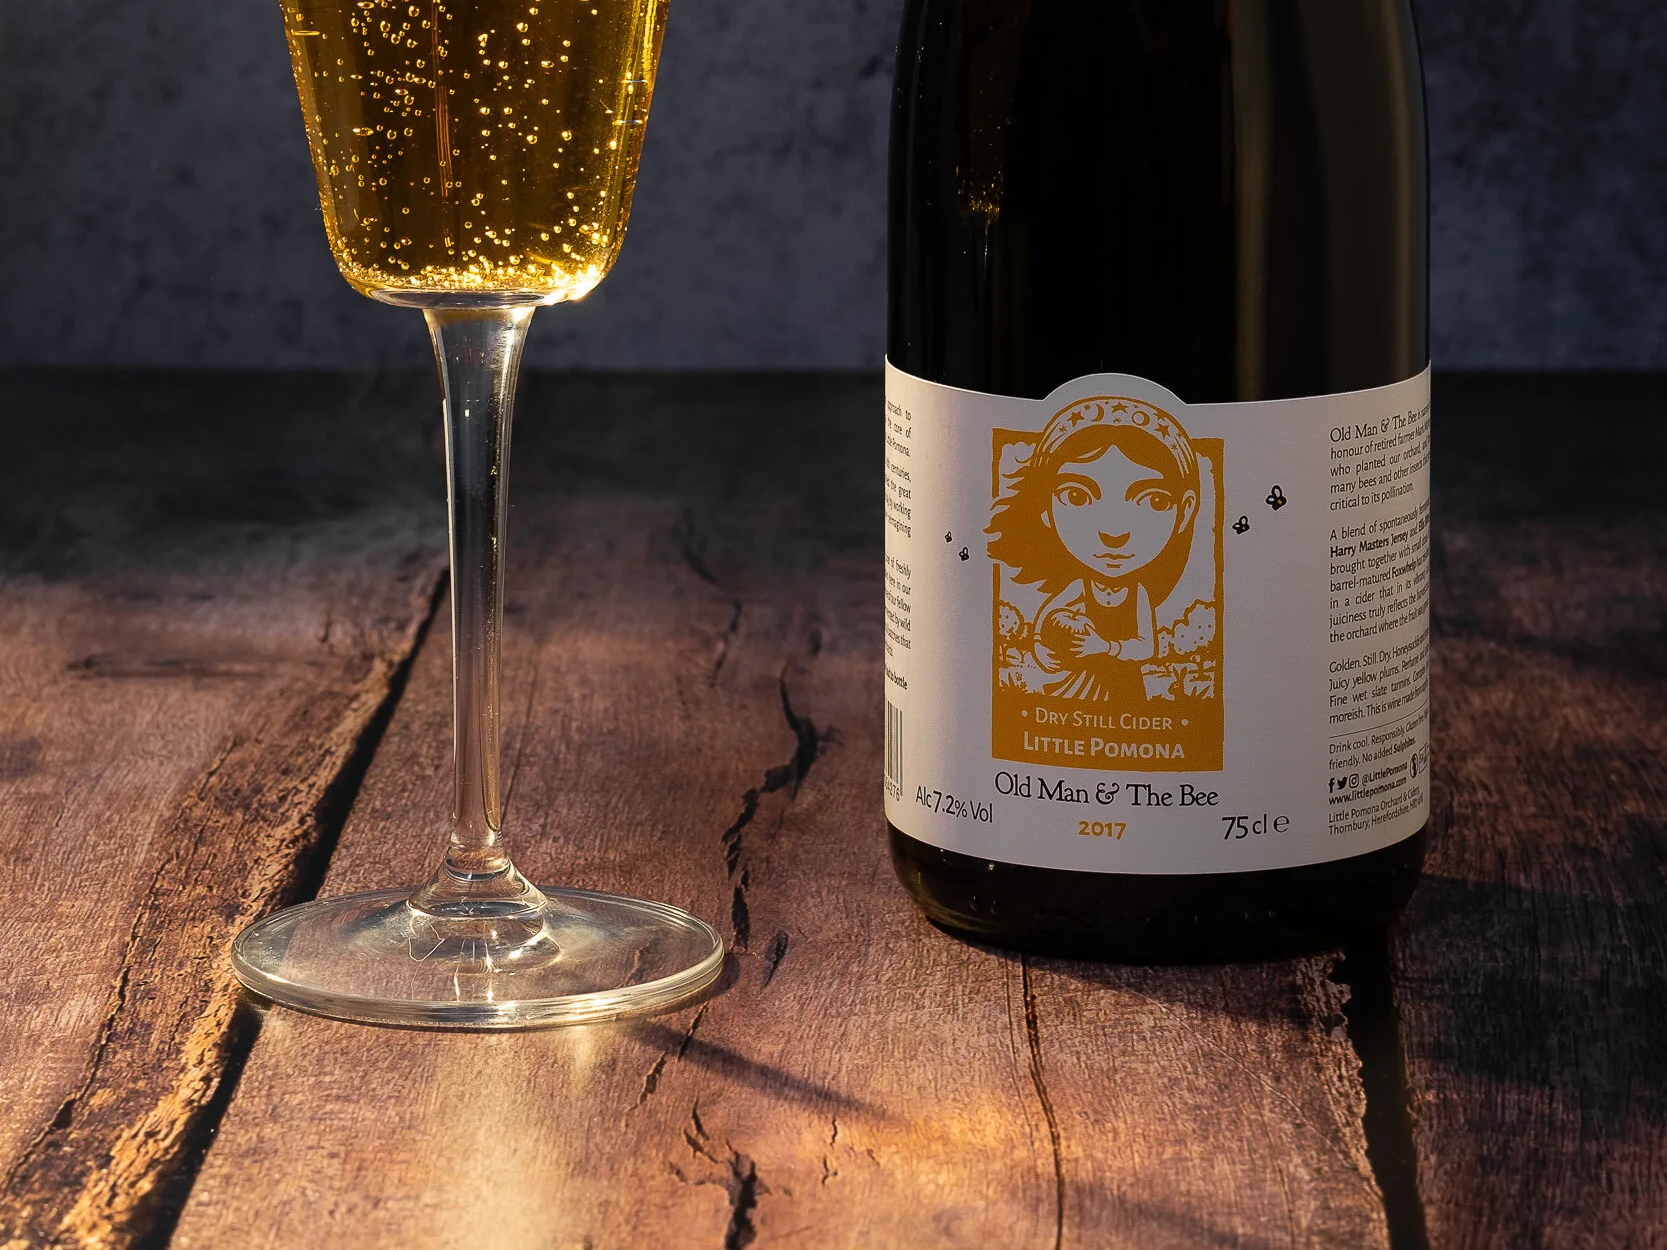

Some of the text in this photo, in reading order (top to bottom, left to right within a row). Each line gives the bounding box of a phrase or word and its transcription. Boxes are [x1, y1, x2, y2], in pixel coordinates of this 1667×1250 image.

[905, 427, 911, 439] of
[1330, 426, 1351, 442] Old
[1355, 423, 1378, 439] Man
[1381, 418, 1390, 433] &
[1392, 415, 1406, 430] The
[1408, 410, 1418, 425] Bee
[1330, 446, 1364, 459] honour
[1364, 440, 1373, 453] of
[1374, 434, 1396, 452] retired
[1397, 429, 1415, 446] farmer
[1330, 463, 1351, 476] who
[1356, 454, 1385, 475] planted
[1389, 453, 1401, 465] our
[1330, 479, 1356, 494] many
[1359, 477, 1377, 489] bees
[1378, 470, 1392, 484] and
[1394, 465, 1409, 481] other
[898, 487, 911, 499] great
[1330, 495, 1360, 511] critical
[1361, 495, 1370, 506] to
[1371, 490, 1380, 503] its
[1330, 529, 1337, 541] A
[1341, 523, 1366, 540] blend
[1368, 520, 1377, 534] of
[1380, 507, 1418, 532] spontaneously
[1330, 545, 1356, 558] Harry
[1359, 537, 1389, 553] Masters
[1391, 531, 1409, 546] Jersey
[1410, 526, 1418, 538] and
[896, 559, 911, 580] freshly
[1330, 558, 1365, 575] brought
[1368, 551, 1397, 569] together
[1399, 544, 1411, 559] with
[1330, 568, 1391, 592] barrel-matured
[1392, 559, 1416, 579] Foxwhelp
[902, 584, 911, 595] our
[1330, 597, 1339, 609] in
[1344, 597, 1350, 607] a
[1355, 591, 1375, 605] cider
[1379, 585, 1393, 599] that
[1397, 582, 1402, 594] in
[897, 595, 911, 613] fellow
[1329, 611, 1367, 629] juiciness
[1369, 603, 1386, 619] truly
[1387, 597, 1408, 614] reflects
[900, 619, 911, 632] wild
[1330, 631, 1345, 643] the
[1346, 622, 1378, 640] orchard
[1378, 619, 1398, 633] where
[1399, 614, 1408, 626] the
[901, 635, 911, 649] that
[1329, 658, 1361, 673] Golden.
[1363, 652, 1378, 667] Still.
[1380, 650, 1392, 664] Dry.
[1329, 678, 1350, 692] Juicy
[1352, 672, 1377, 689] yellow
[1329, 695, 1348, 707] Fine
[1352, 690, 1367, 703] wet
[1372, 684, 1388, 698] slate
[1329, 707, 1365, 724] moreish.
[1366, 702, 1380, 717] This
[1381, 700, 1387, 712] is
[1387, 697, 1401, 711] wine
[1402, 688, 1415, 704] made
[1329, 740, 1352, 755] Drink
[1353, 736, 1369, 750] cool.
[1329, 753, 1361, 770] friendly.
[1362, 753, 1373, 764] No
[1374, 745, 1393, 761] added
[1362, 762, 1408, 786] @LittlePomona
[995, 771, 1219, 807] Old Man & The Bee
[1329, 776, 1407, 805] www.littlepomona.com
[970, 800, 993, 823] Vol
[1329, 810, 1350, 823] Little
[1351, 805, 1379, 819] Pomona
[1380, 792, 1403, 810] Orchard
[1403, 790, 1408, 801] &
[1078, 820, 1127, 840] 2017
[1329, 820, 1371, 835] Thornbury,
